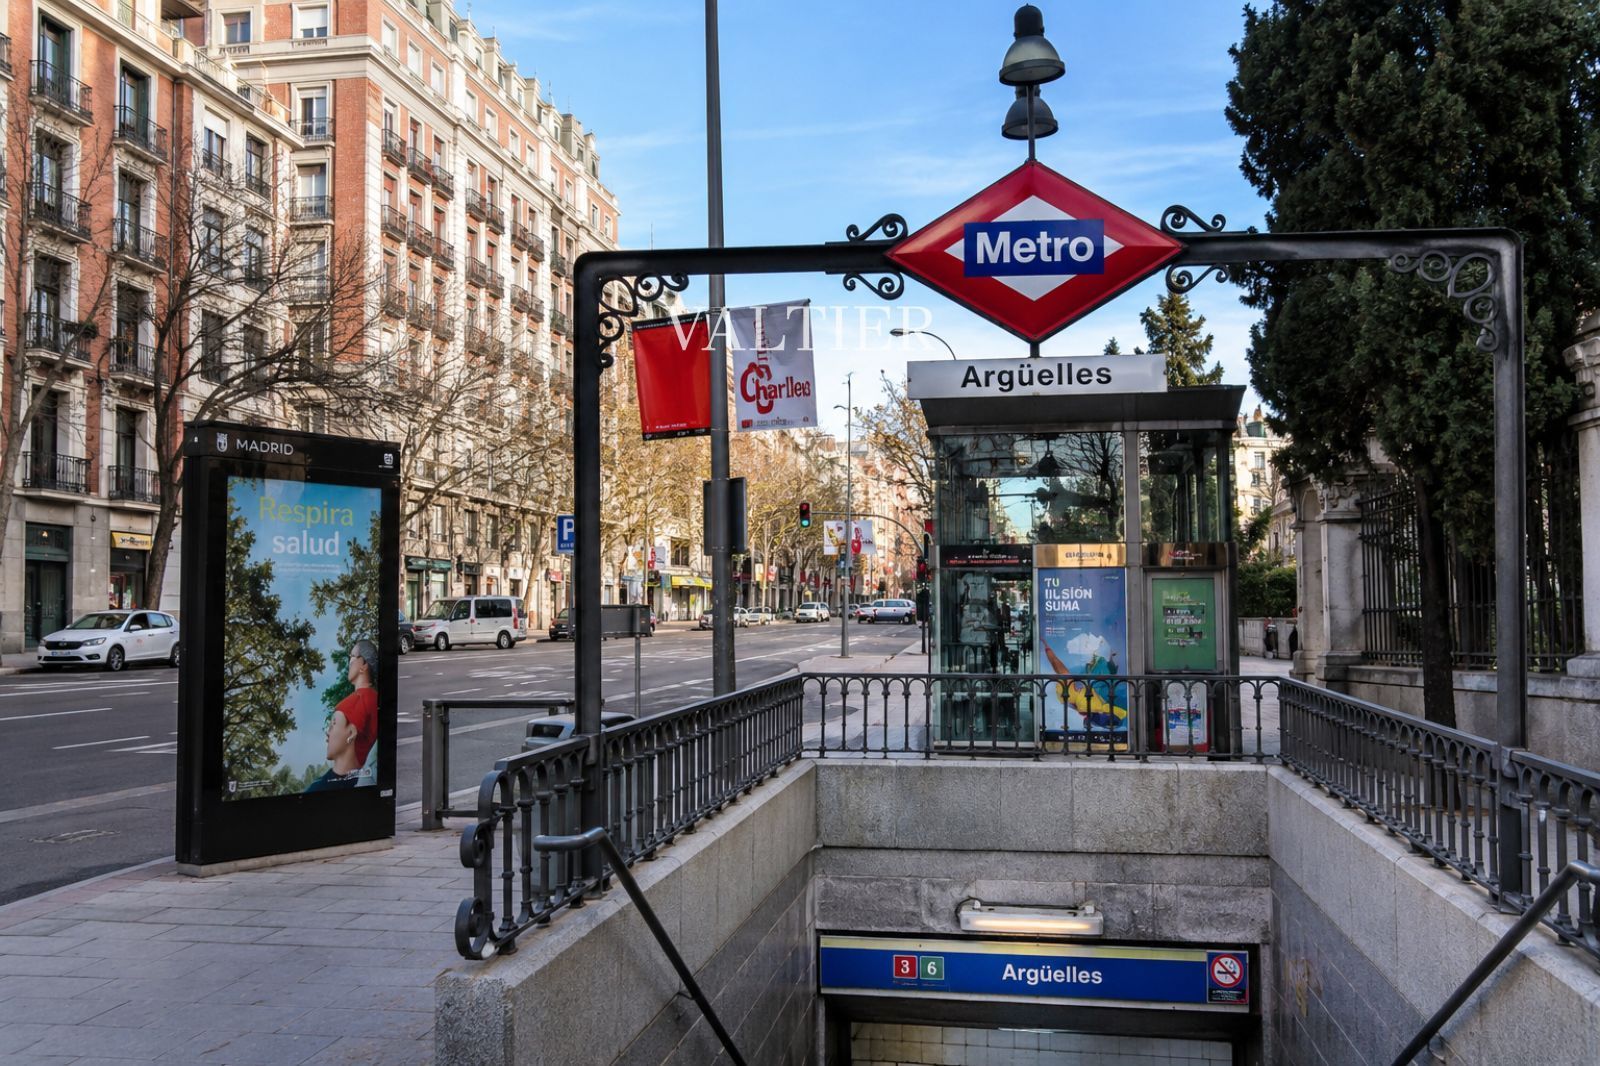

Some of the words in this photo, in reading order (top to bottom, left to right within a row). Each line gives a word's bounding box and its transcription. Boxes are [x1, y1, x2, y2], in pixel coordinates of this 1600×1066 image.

[976, 231, 1094, 264] Metro
[961, 362, 1113, 392] Argüelles
[236, 438, 294, 456] MADRID
[258, 496, 354, 528] Respira
[563, 518, 575, 541] P
[272, 530, 340, 556] salud
[1044, 577, 1060, 588] TU
[1045, 600, 1081, 612] SUMA
[901, 959, 910, 974] 3
[927, 961, 937, 976] 6
[1002, 963, 1103, 985] Argüelles
